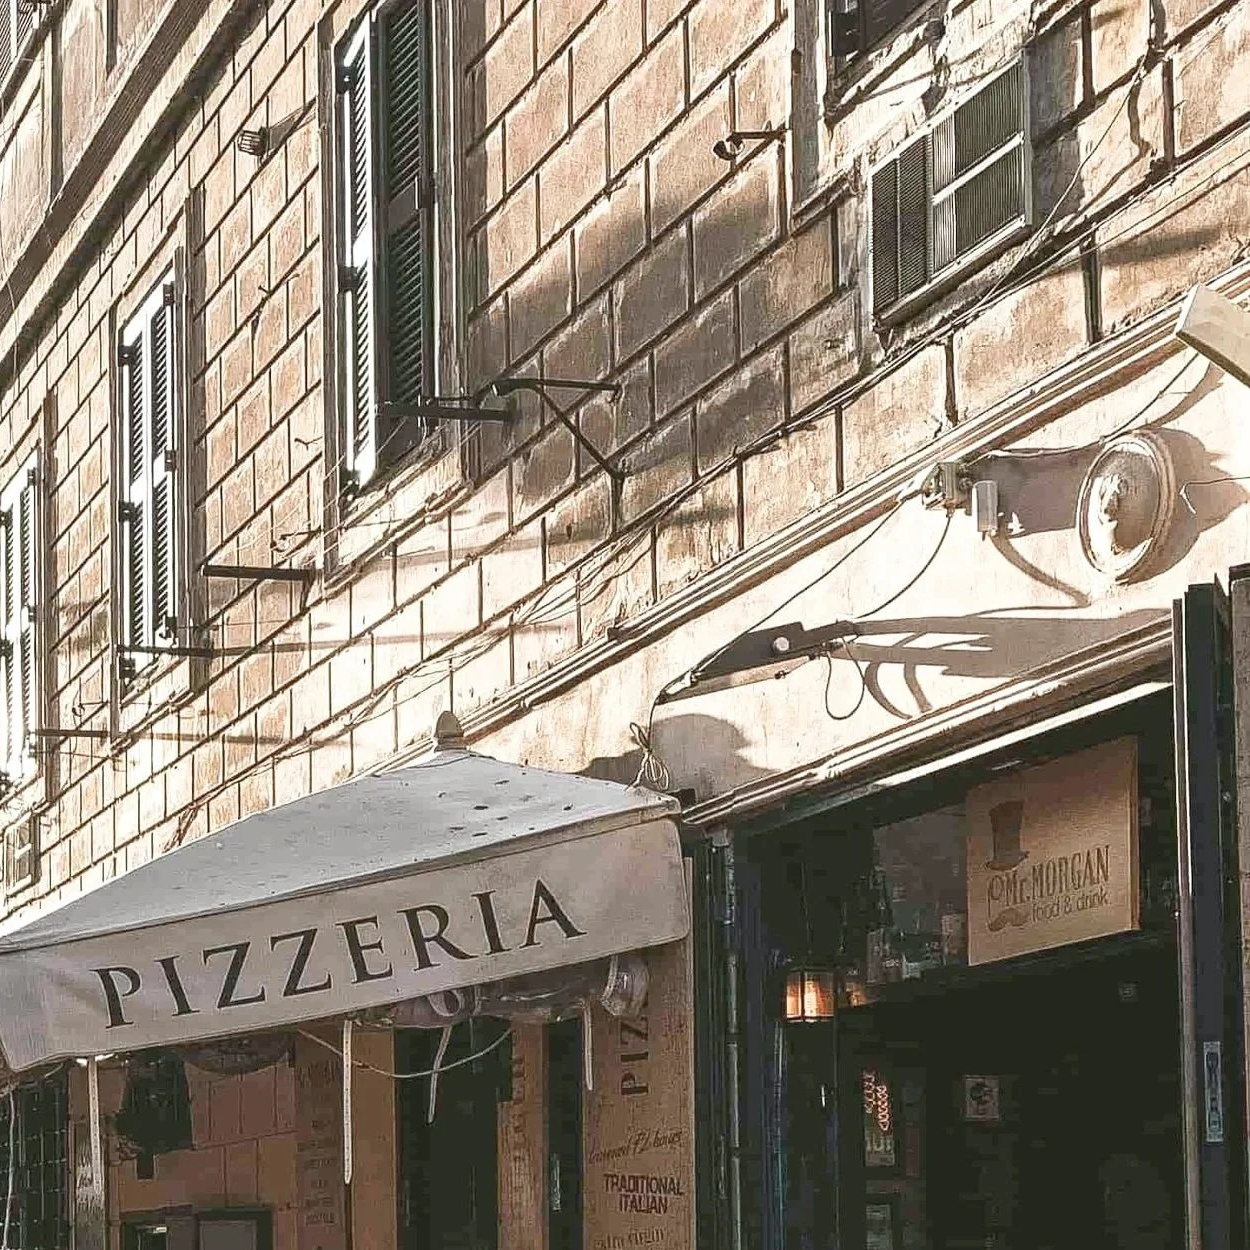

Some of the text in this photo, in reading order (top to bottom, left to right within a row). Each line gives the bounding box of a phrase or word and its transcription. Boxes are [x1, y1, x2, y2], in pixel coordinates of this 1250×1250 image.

[1032, 896, 1060, 922] food
[89, 878, 588, 1029] PIZZERIA
[620, 1010, 649, 1096] PIZ
[603, 1173, 685, 1196] TRADITIONAL
[618, 1192, 668, 1214] ITALIAN
